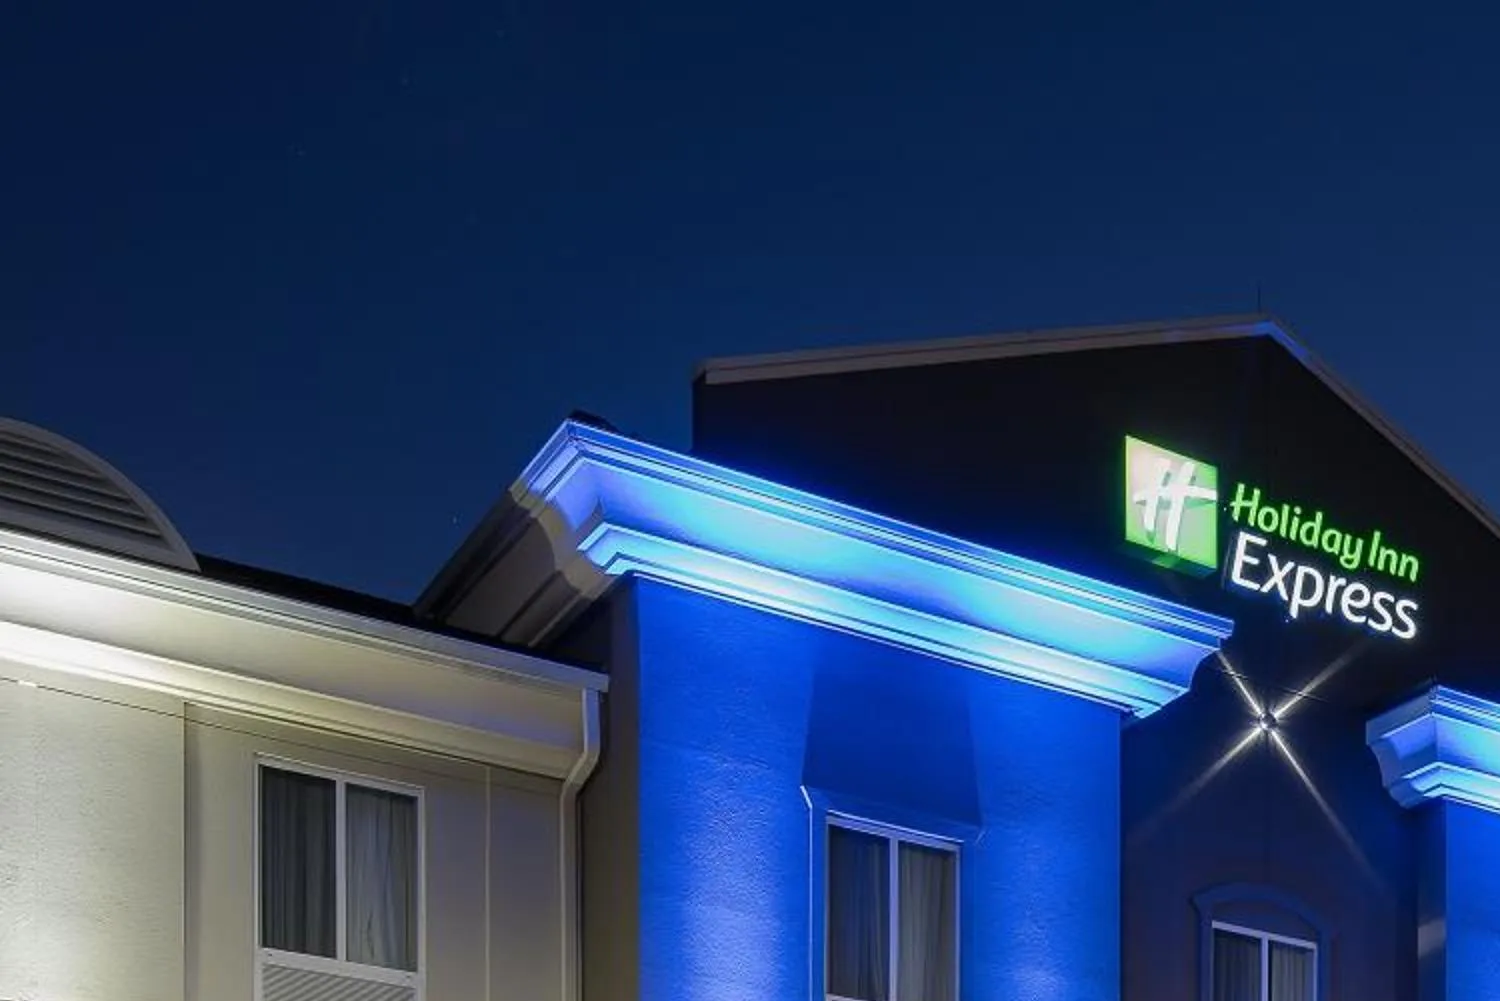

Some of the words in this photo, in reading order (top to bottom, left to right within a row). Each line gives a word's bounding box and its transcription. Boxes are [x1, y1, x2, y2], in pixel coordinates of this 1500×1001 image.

[1230, 483, 1362, 568] Holiday
[1368, 531, 1419, 582] Inn
[1230, 531, 1419, 640] Express
